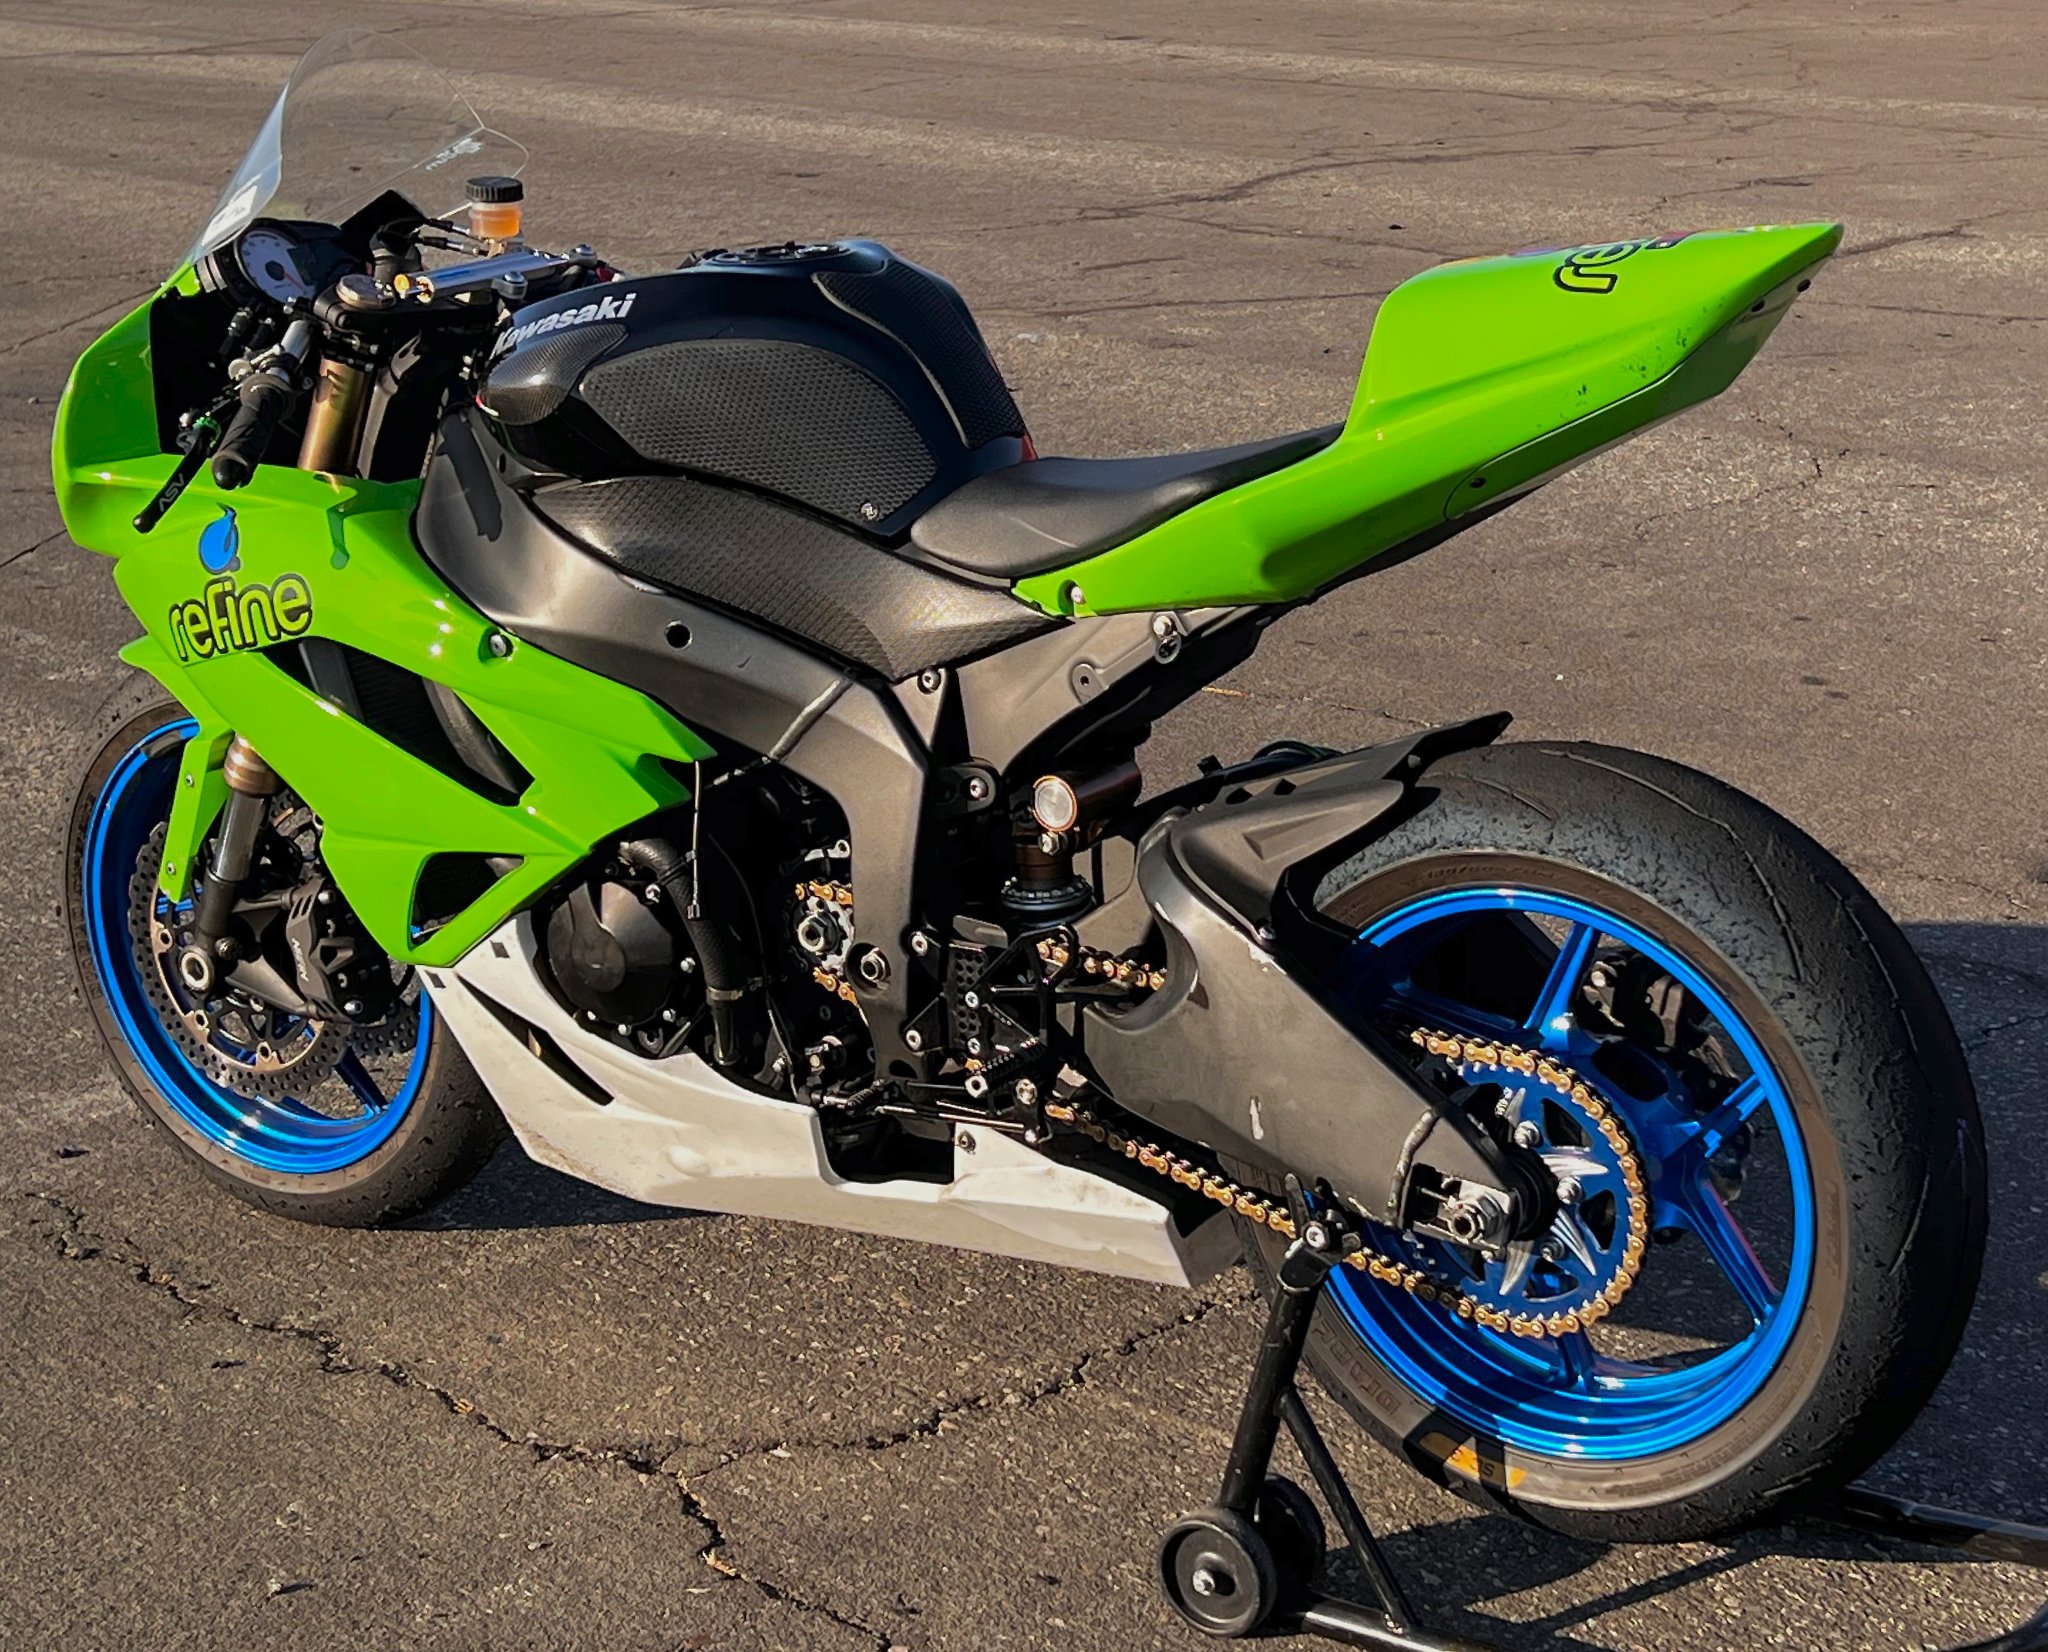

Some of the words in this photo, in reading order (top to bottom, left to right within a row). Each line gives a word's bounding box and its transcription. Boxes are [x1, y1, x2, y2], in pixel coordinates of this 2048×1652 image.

[486, 292, 637, 362] Kawasaki
[159, 473, 185, 512] ASV
[169, 572, 313, 662] refine
